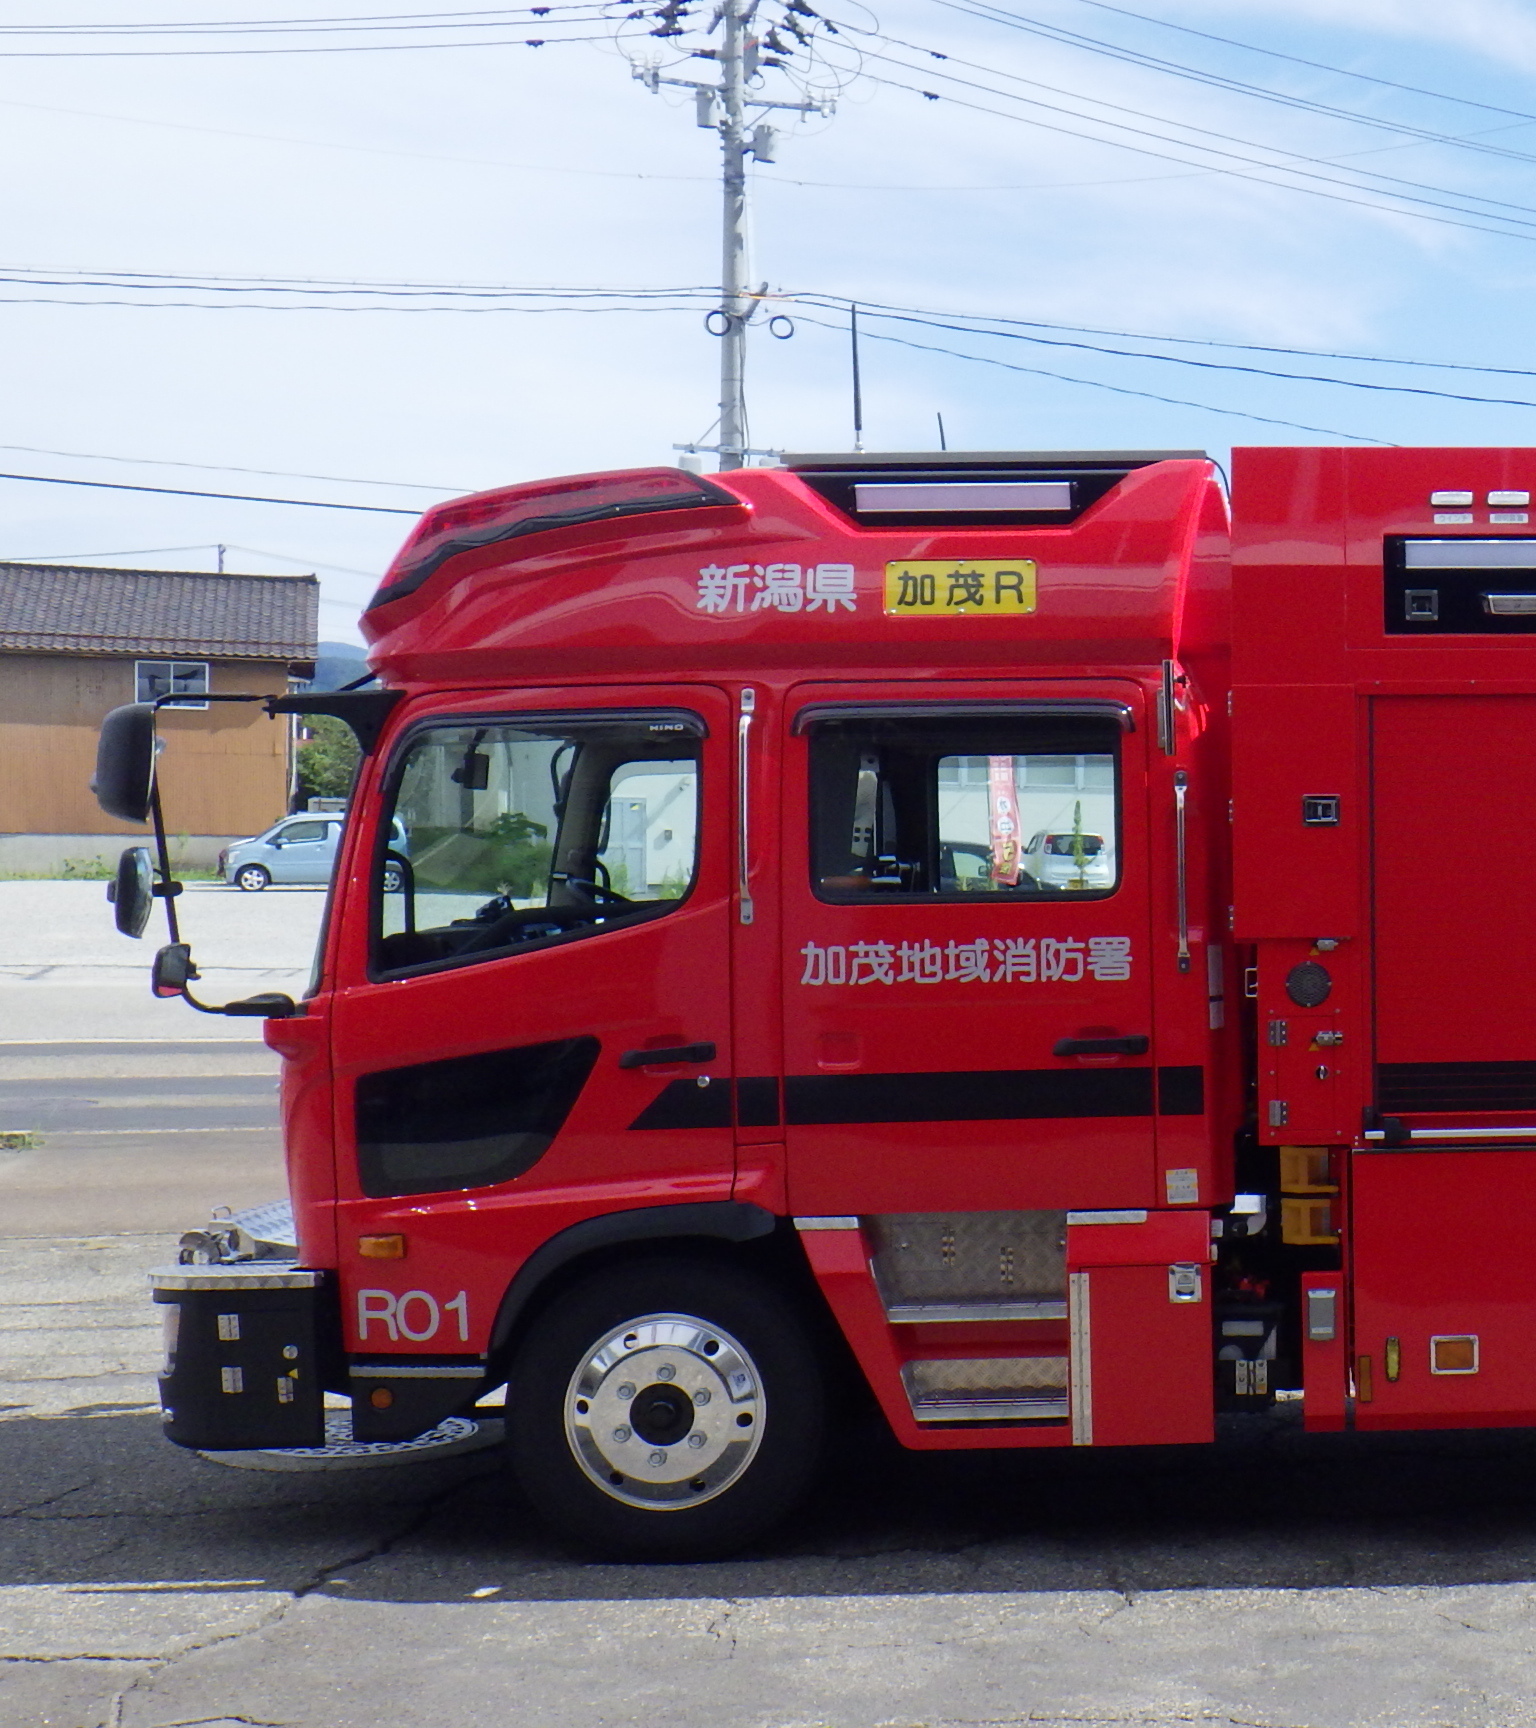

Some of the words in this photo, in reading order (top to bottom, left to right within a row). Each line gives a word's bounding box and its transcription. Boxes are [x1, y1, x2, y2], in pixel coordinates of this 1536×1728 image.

[697, 563, 857, 613] 新潟県
[896, 569, 1025, 608] 加茂R
[800, 935, 1133, 986] 加茂地域消防署
